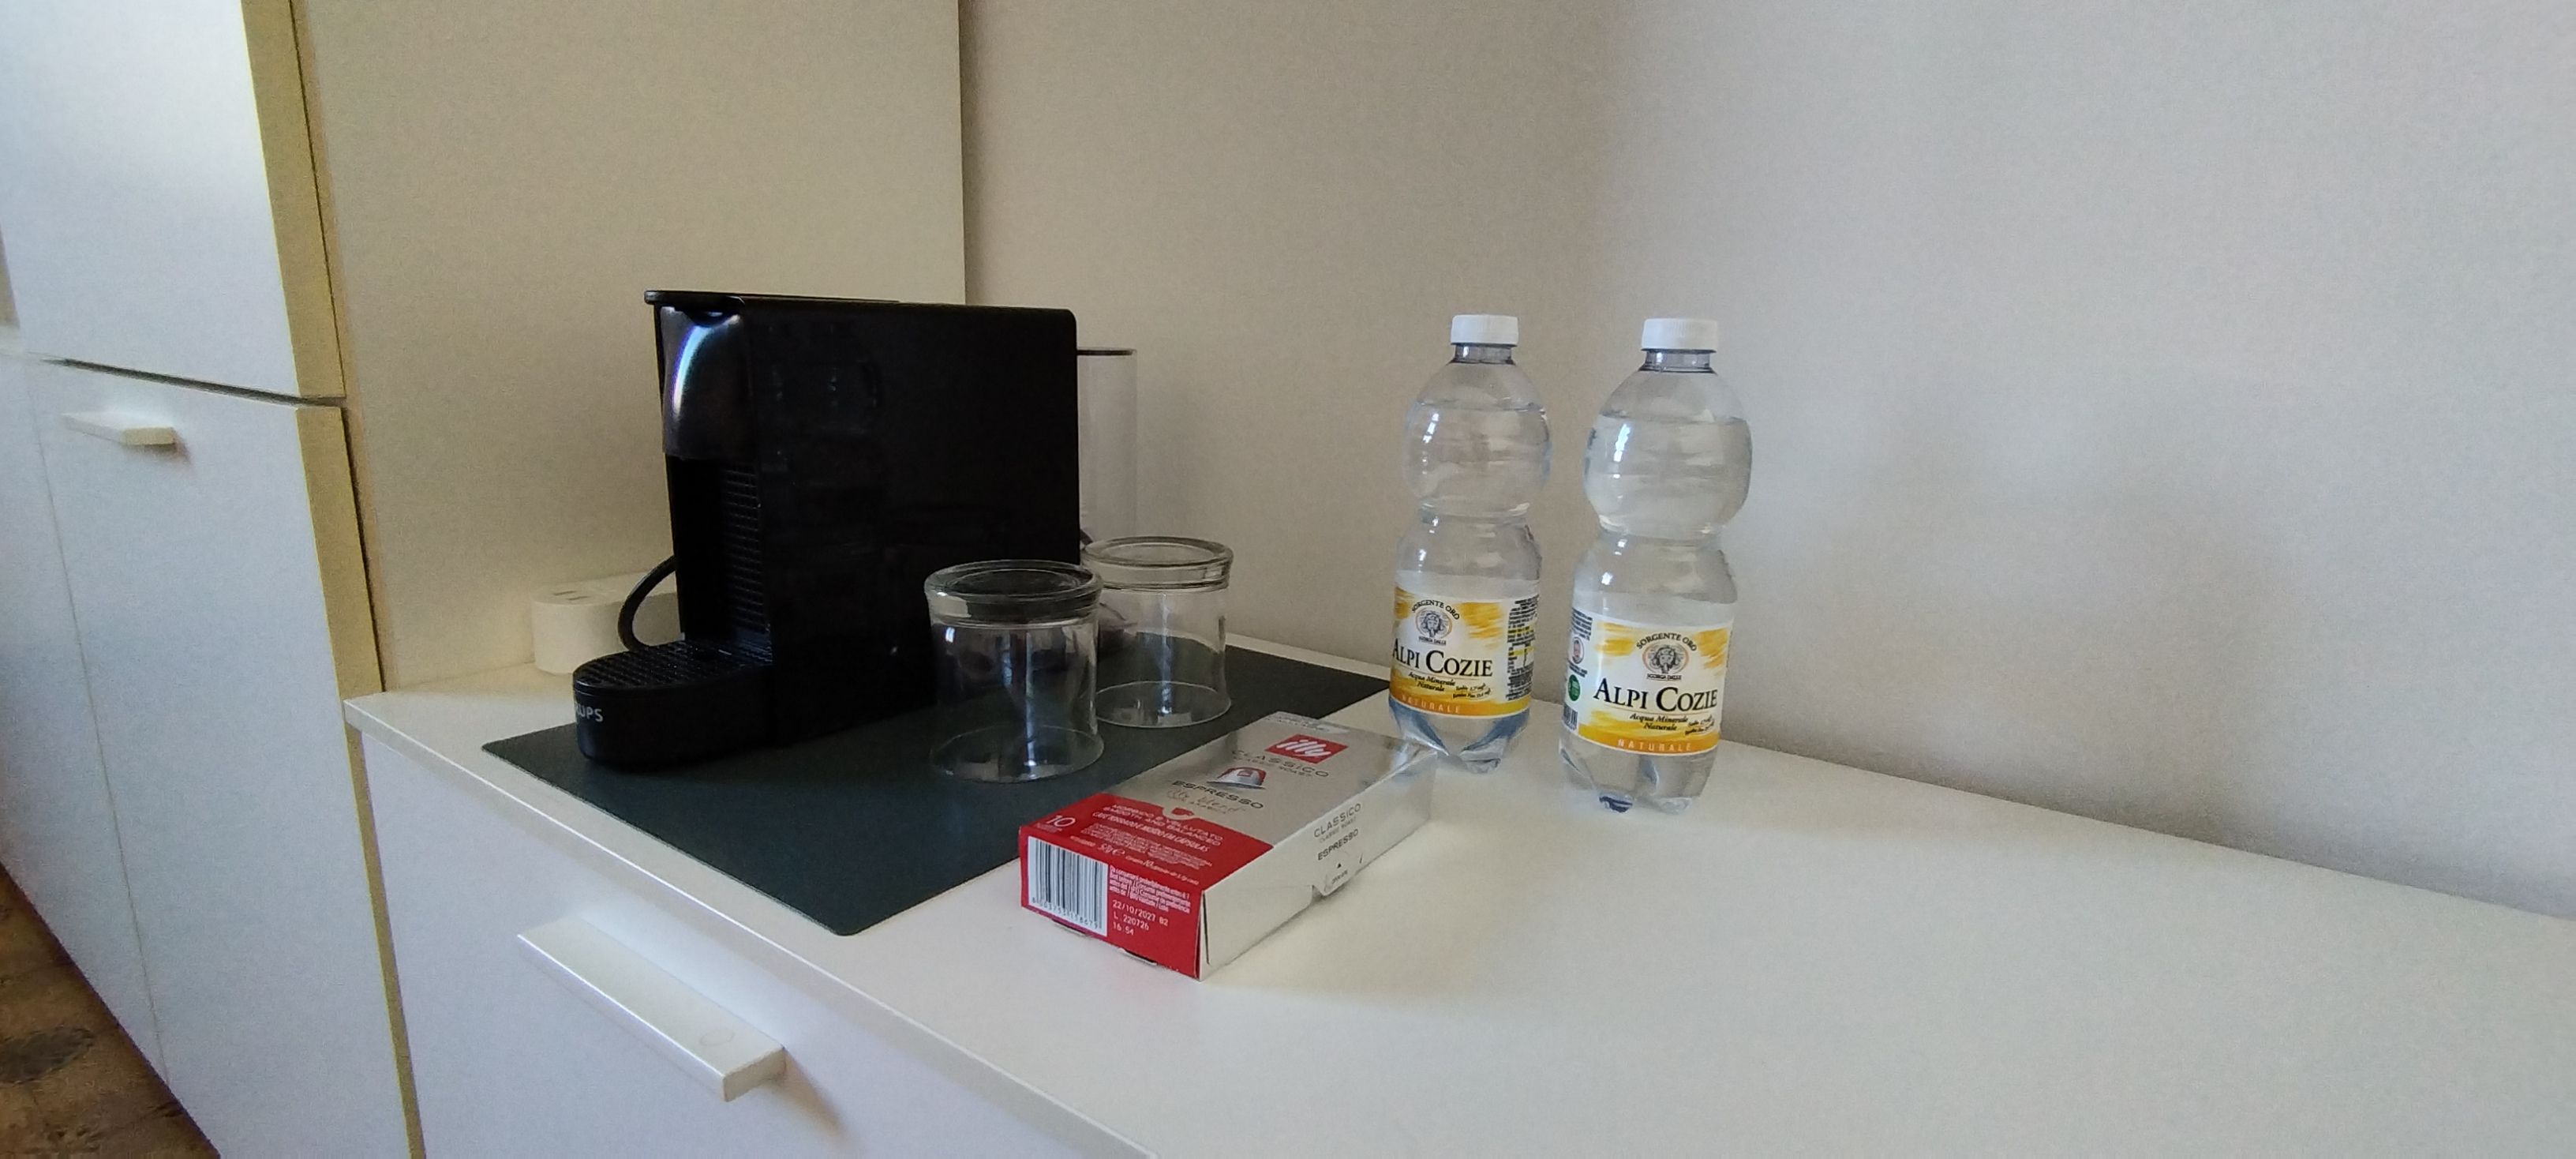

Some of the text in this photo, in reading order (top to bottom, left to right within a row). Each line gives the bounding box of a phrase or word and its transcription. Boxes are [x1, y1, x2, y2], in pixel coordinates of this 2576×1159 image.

[1411, 599, 1460, 621] SORGENTE ORO
[1636, 632, 1698, 651] SORGENTE ORO
[1393, 638, 1493, 677] ALPI COZIE
[1593, 677, 1718, 712] ALPI COZIE
[1629, 713, 1655, 723] Acqua
[1655, 715, 1689, 723] Minerale
[1644, 722, 1678, 731] Naturale
[1276, 739, 1332, 758] illy
[1618, 738, 1692, 752] NATURALE
[1231, 749, 1329, 778] CLASSICO
[1171, 780, 1264, 809] ESPRESSO
[1046, 815, 1076, 827] 10
[1313, 802, 1362, 838] CLASSICO
[1144, 817, 1166, 827] AND
[1166, 824, 1222, 846] BALANCED
[1317, 828, 1360, 861] ESPRESSO
[1112, 899, 1156, 922] 22/10/2027
[1113, 910, 1150, 932] L 220726
[1113, 921, 1135, 936] 16 54
